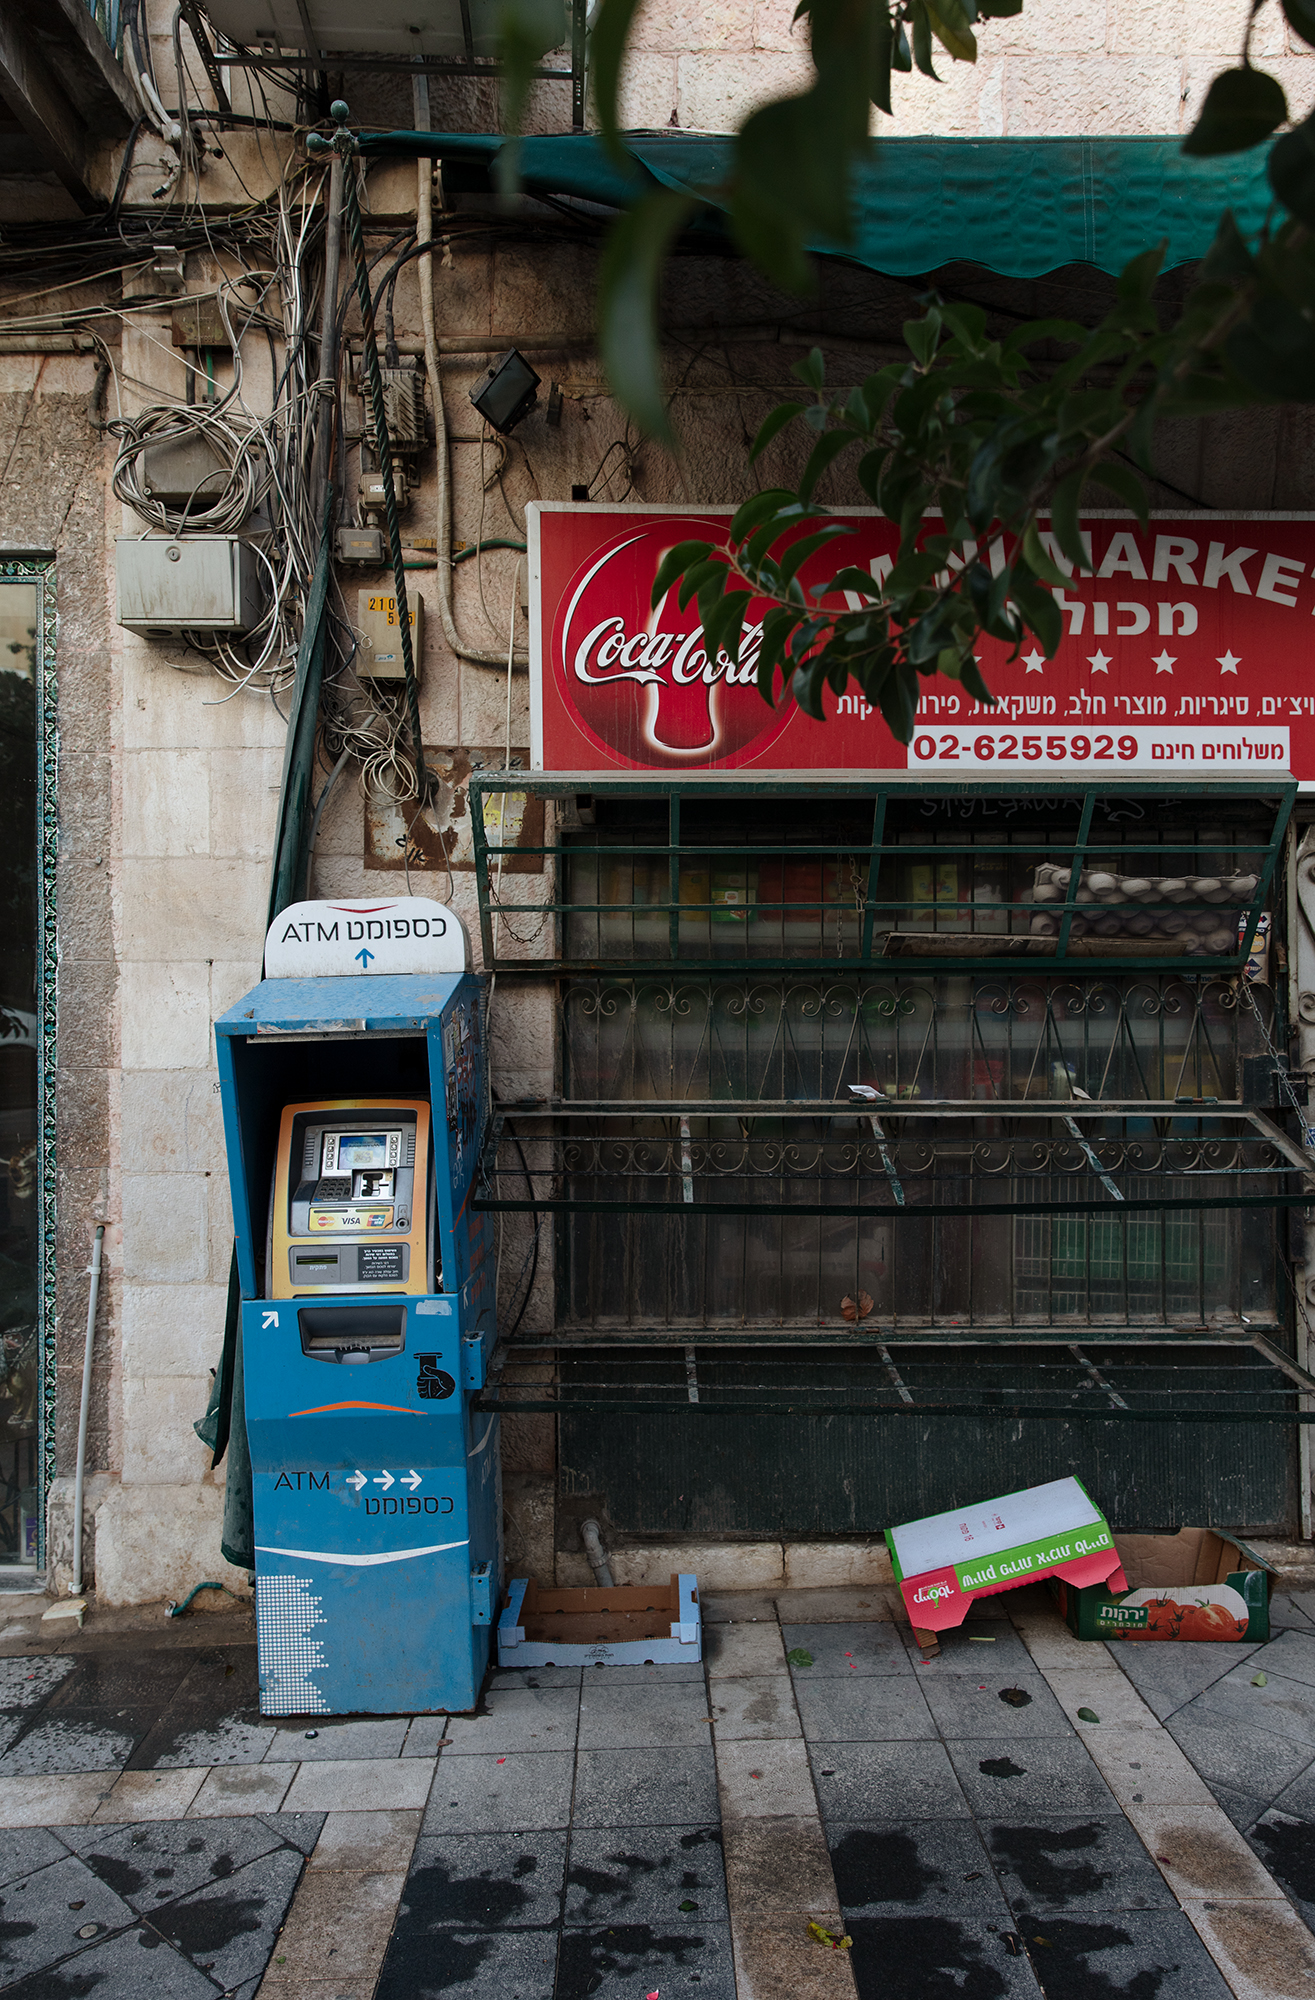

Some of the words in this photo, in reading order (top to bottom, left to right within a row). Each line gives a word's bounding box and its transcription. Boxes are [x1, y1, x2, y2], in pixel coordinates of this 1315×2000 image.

[1038, 531, 1315, 617] MARKE
[369, 597, 395, 611] 210
[1006, 588, 1198, 636] מכול
[916, 695, 961, 715] פירו
[1064, 688, 1106, 717] חלב,
[1114, 696, 1167, 715] מוצרי
[1174, 696, 1249, 717] סיגריות,
[913, 734, 1139, 761] 02-6255929
[1151, 743, 1195, 760] חינם
[1202, 736, 1285, 760] משלוחים
[281, 921, 339, 943] ATM
[346, 918, 447, 941] כספומט
[341, 1217, 361, 1225] VISA
[273, 1471, 331, 1491] ATM
[364, 1496, 454, 1515] כספומט
[962, 1564, 997, 1588] שיווק
[999, 1556, 1033, 1576] פירות
[1036, 1544, 1071, 1565] איכות
[1075, 1533, 1110, 1556] טריים
[1100, 1605, 1145, 1621] ירקות
